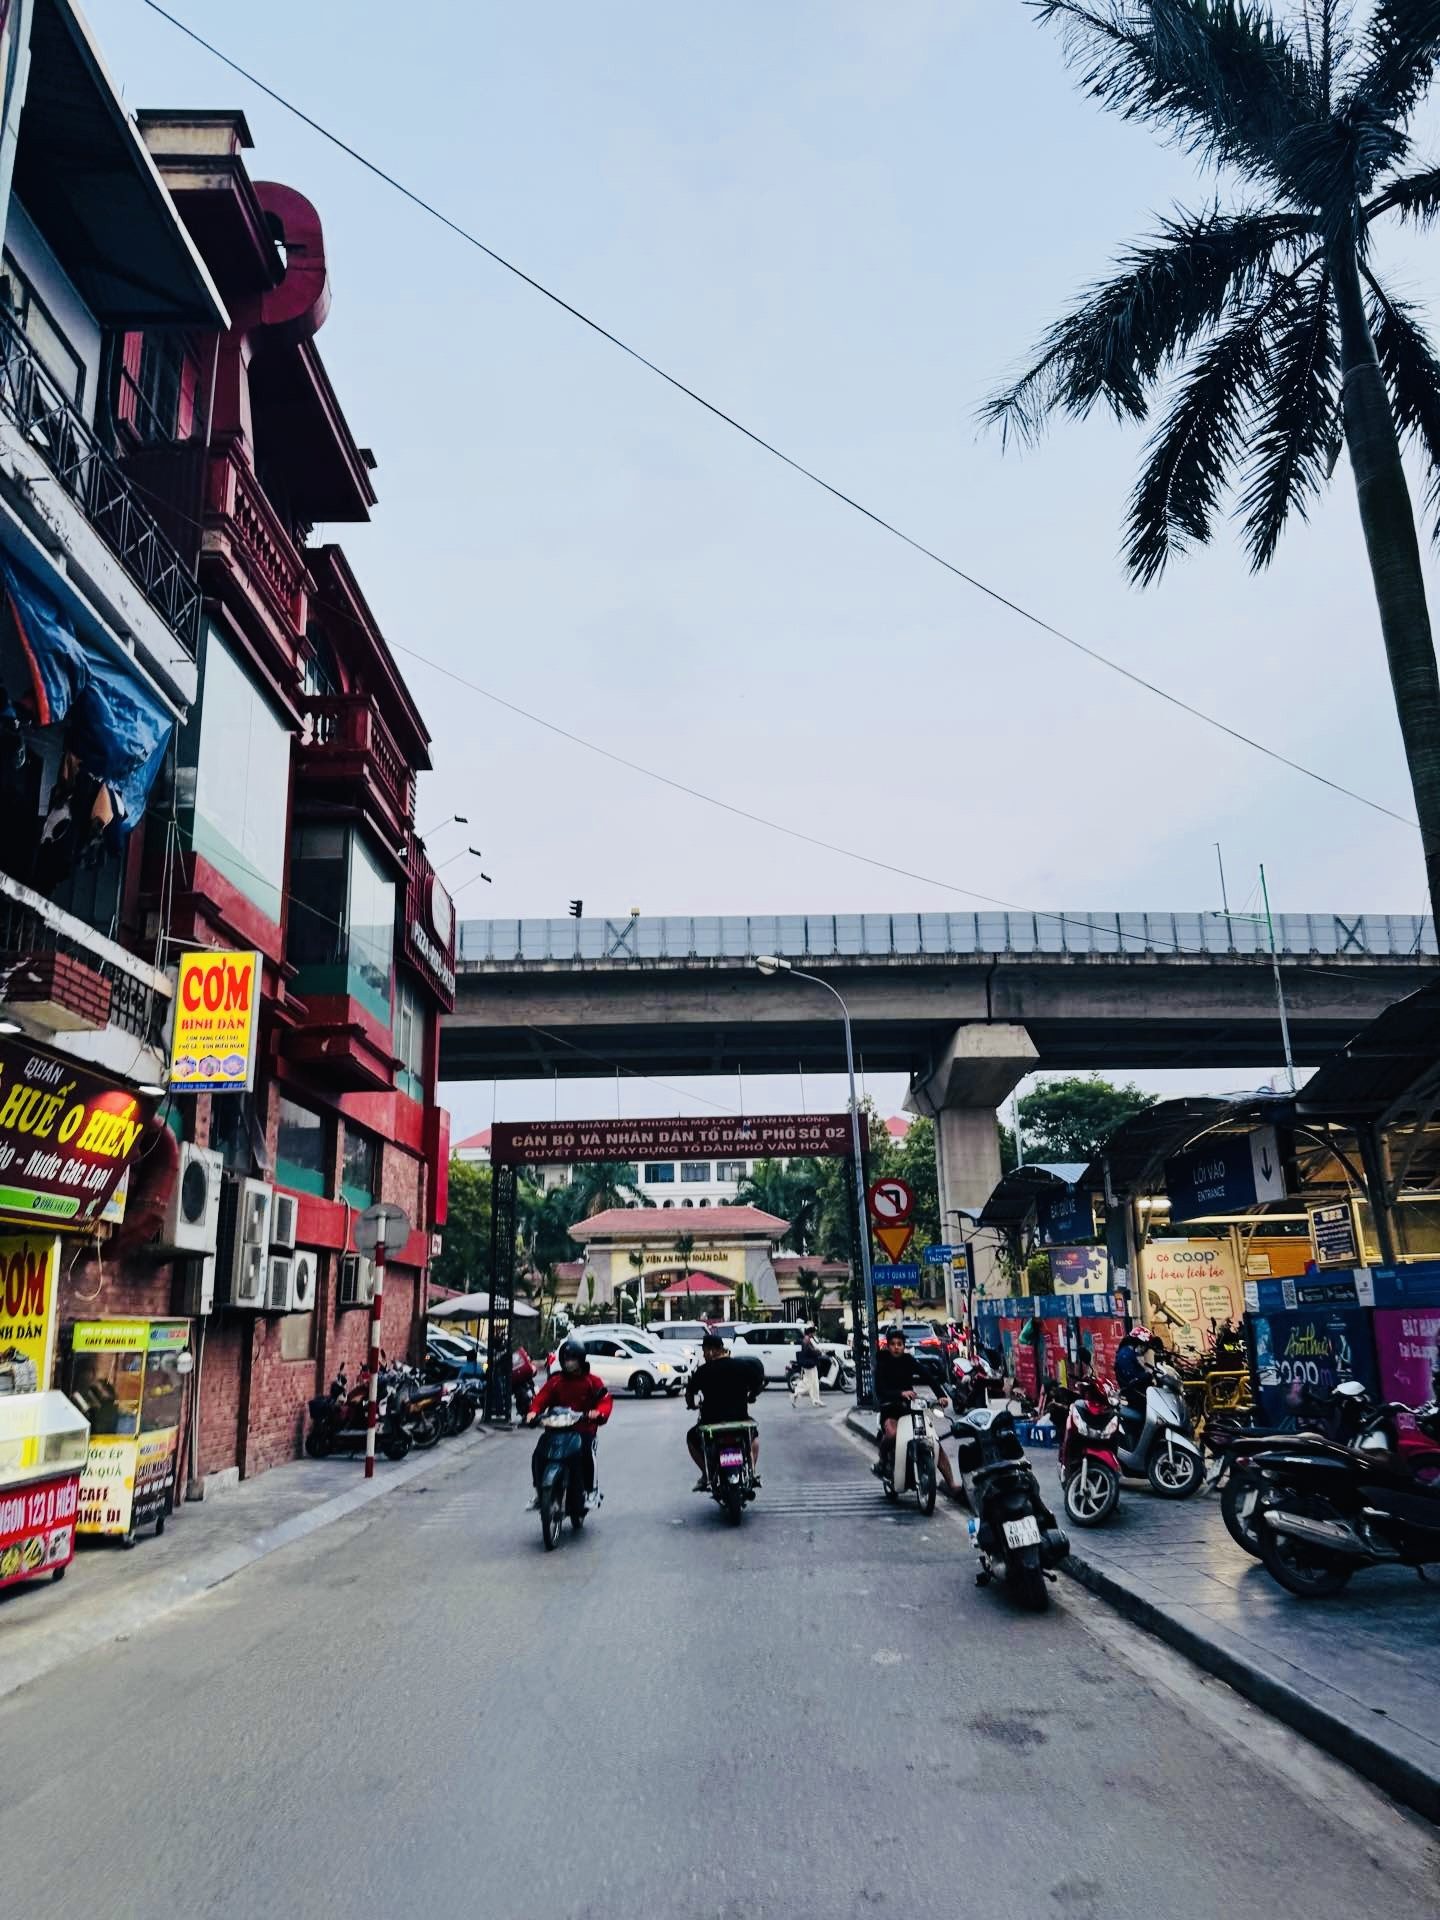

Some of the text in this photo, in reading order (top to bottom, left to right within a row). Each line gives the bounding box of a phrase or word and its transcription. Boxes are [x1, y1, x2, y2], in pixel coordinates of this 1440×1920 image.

[182, 957, 252, 1012] CƠM
[217, 1014, 246, 1030] DÂN
[23, 1054, 65, 1085] QUÁN
[0, 1080, 77, 1138] HUẾ
[57, 1103, 86, 1144] O
[552, 1131, 575, 1147] BỘ
[580, 1130, 601, 1145] VÀ
[606, 1129, 654, 1145] NHÂN
[658, 1128, 694, 1143] DÂN
[762, 1125, 797, 1140] PHỐ
[798, 1124, 822, 1139] SỐ
[825, 1127, 846, 1139] 02
[23, 1149, 64, 1182] Nước
[58, 1157, 88, 1186] Các
[81, 1163, 114, 1194] Loại
[1197, 1185, 1226, 1202] ENTRANCE
[16, 1321, 43, 1340] DÂN
[27, 1491, 46, 1529] 123
